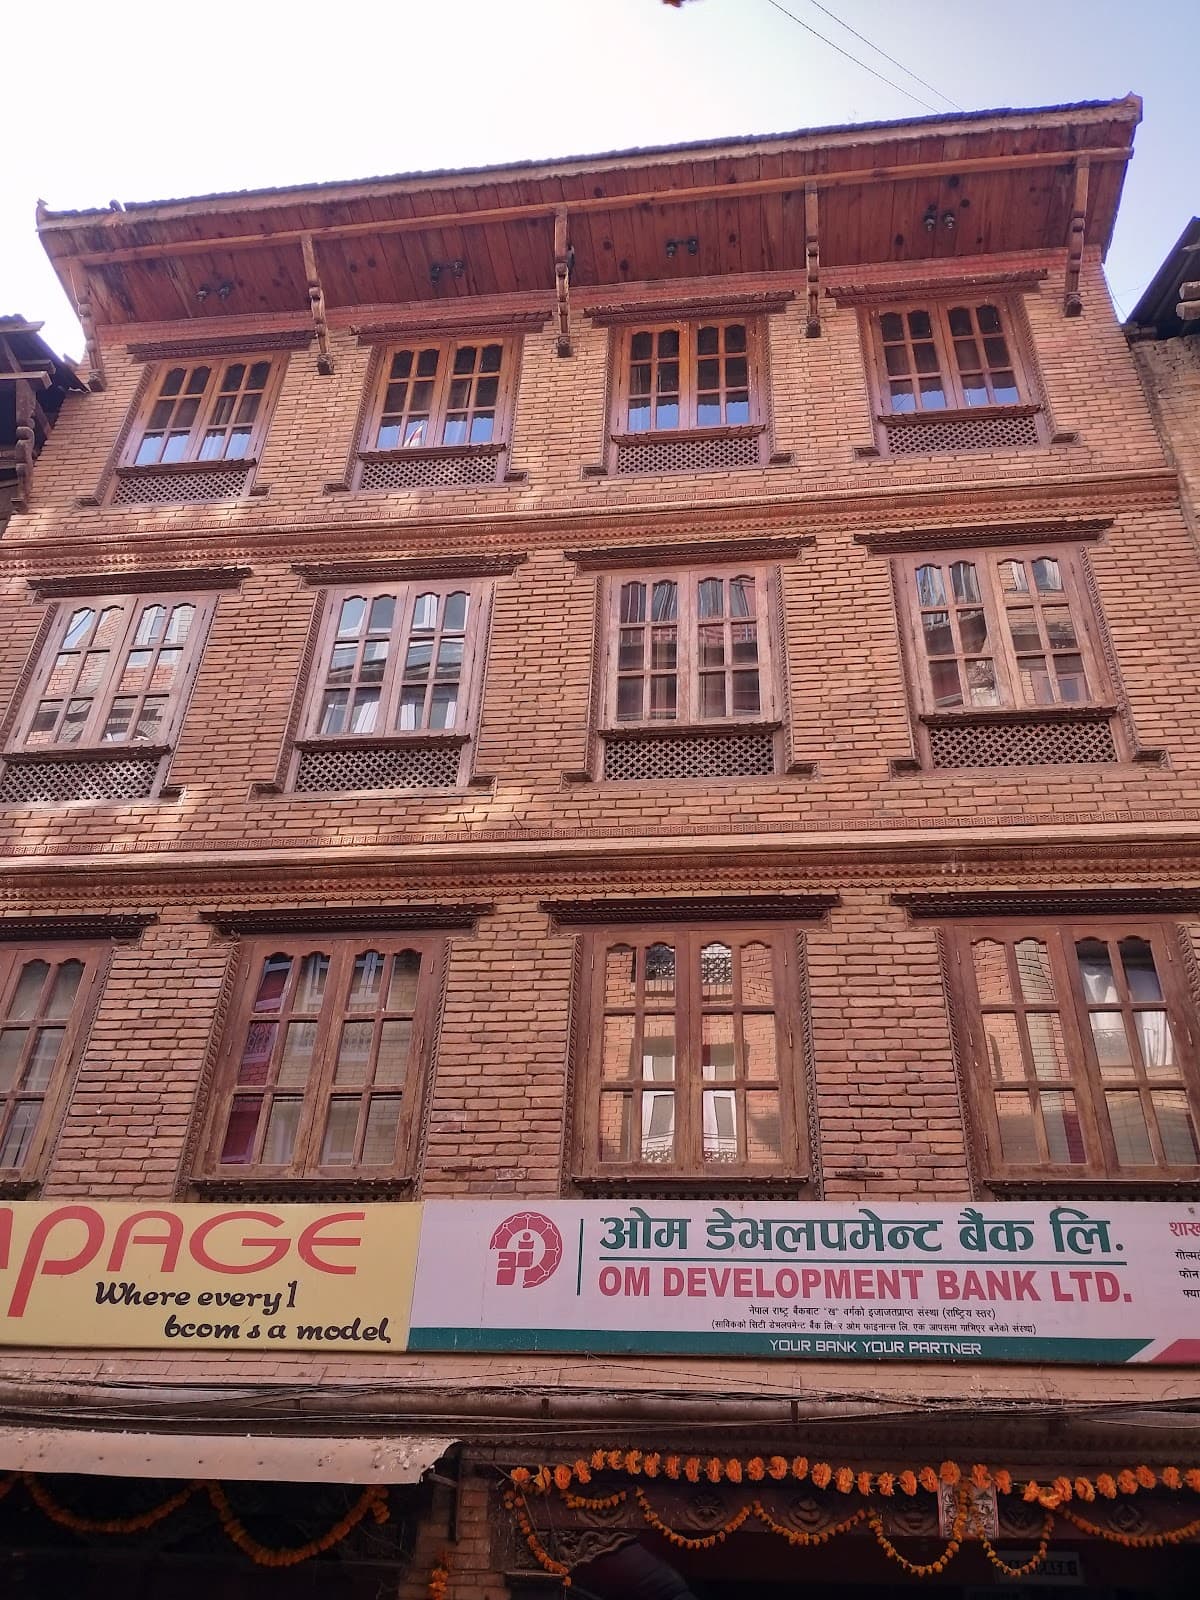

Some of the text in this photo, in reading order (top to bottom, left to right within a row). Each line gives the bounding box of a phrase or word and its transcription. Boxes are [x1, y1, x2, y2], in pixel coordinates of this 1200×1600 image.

[600, 1206, 1124, 1255] ओम डेभलपमेन्ट बैंक लि.
[598, 1266, 1133, 1303] OM DEVELOPMENT BANK LTD.
[95, 1281, 191, 1306] Where
[748, 1304, 769, 1315] नेपाल
[772, 1306, 789, 1318] राष्ट्र
[843, 1305, 865, 1317] वर्गको
[868, 1307, 914, 1319] इजाजतप्राप्त
[917, 1306, 939, 1318] संस्था
[267, 1324, 288, 1340] a
[749, 1318, 766, 1330] सिटी
[913, 1323, 927, 1333] एक
[769, 1339, 983, 1356] YOUR BANK YOUR PARTNER
